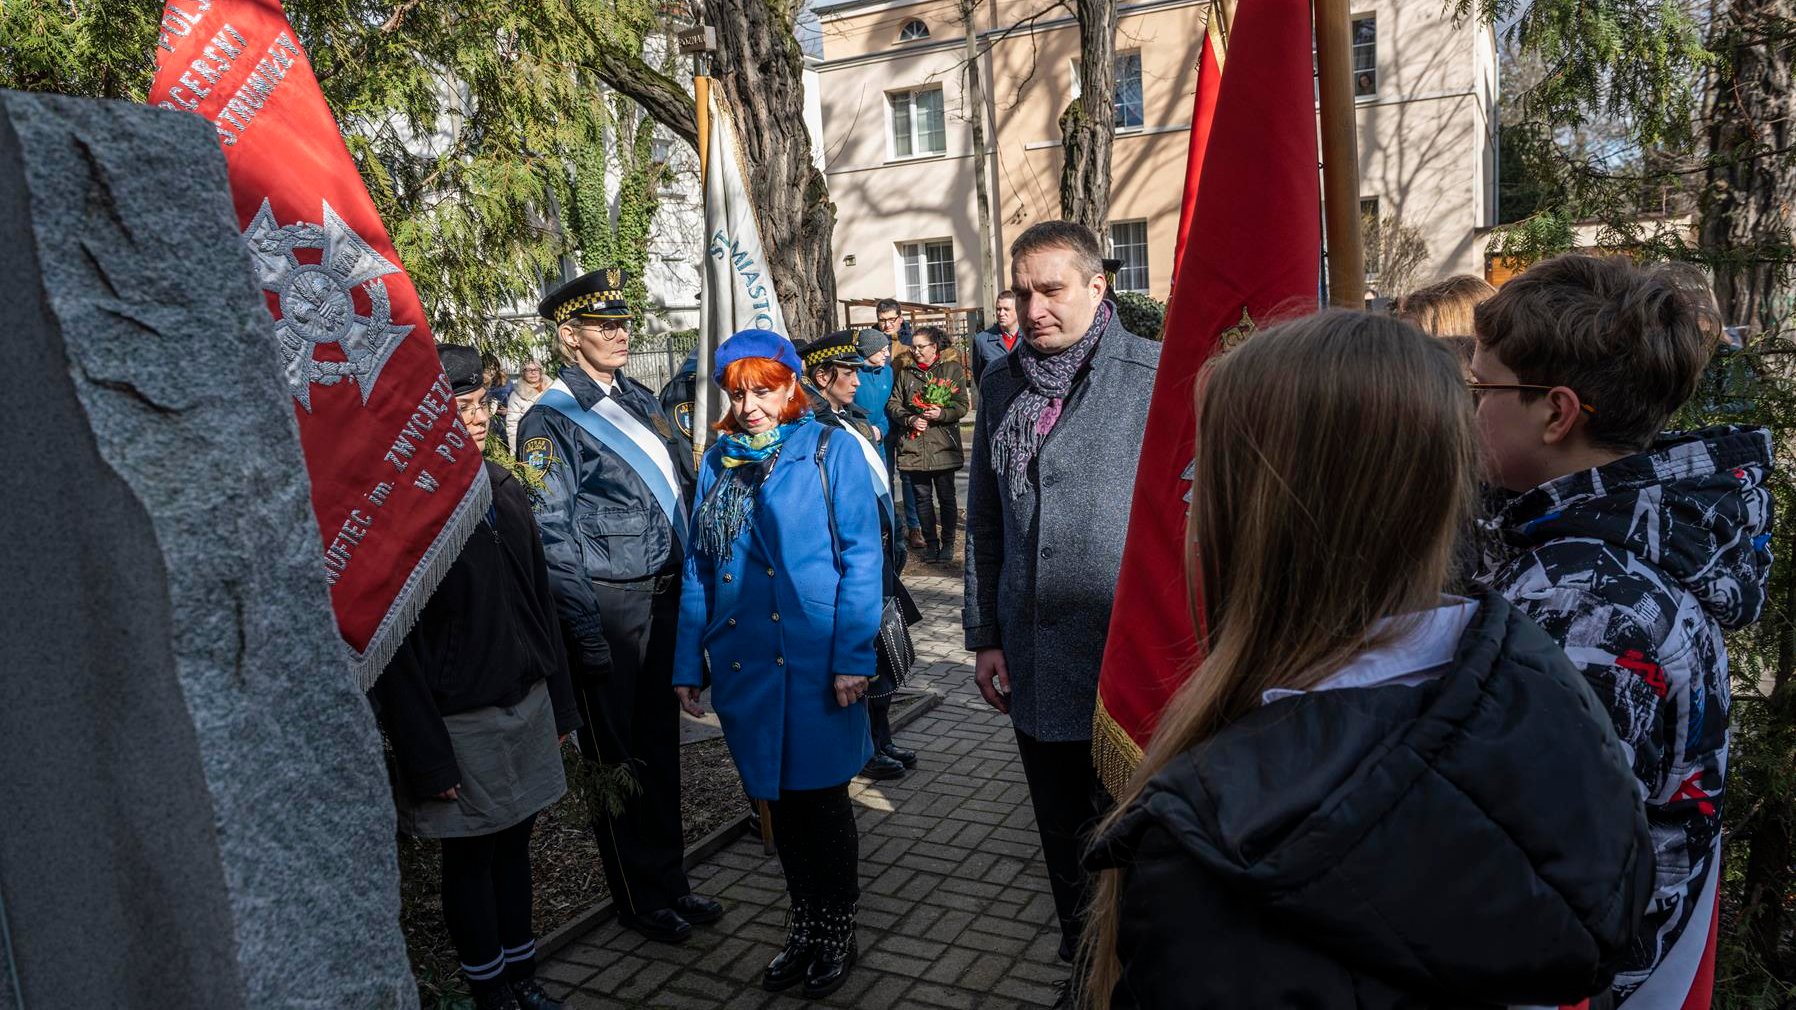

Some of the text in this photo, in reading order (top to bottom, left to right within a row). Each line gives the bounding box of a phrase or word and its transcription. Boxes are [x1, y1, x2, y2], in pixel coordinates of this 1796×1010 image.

[731, 240, 774, 331] MIASTO
[362, 481, 396, 507] im.
[413, 469, 441, 494] W
